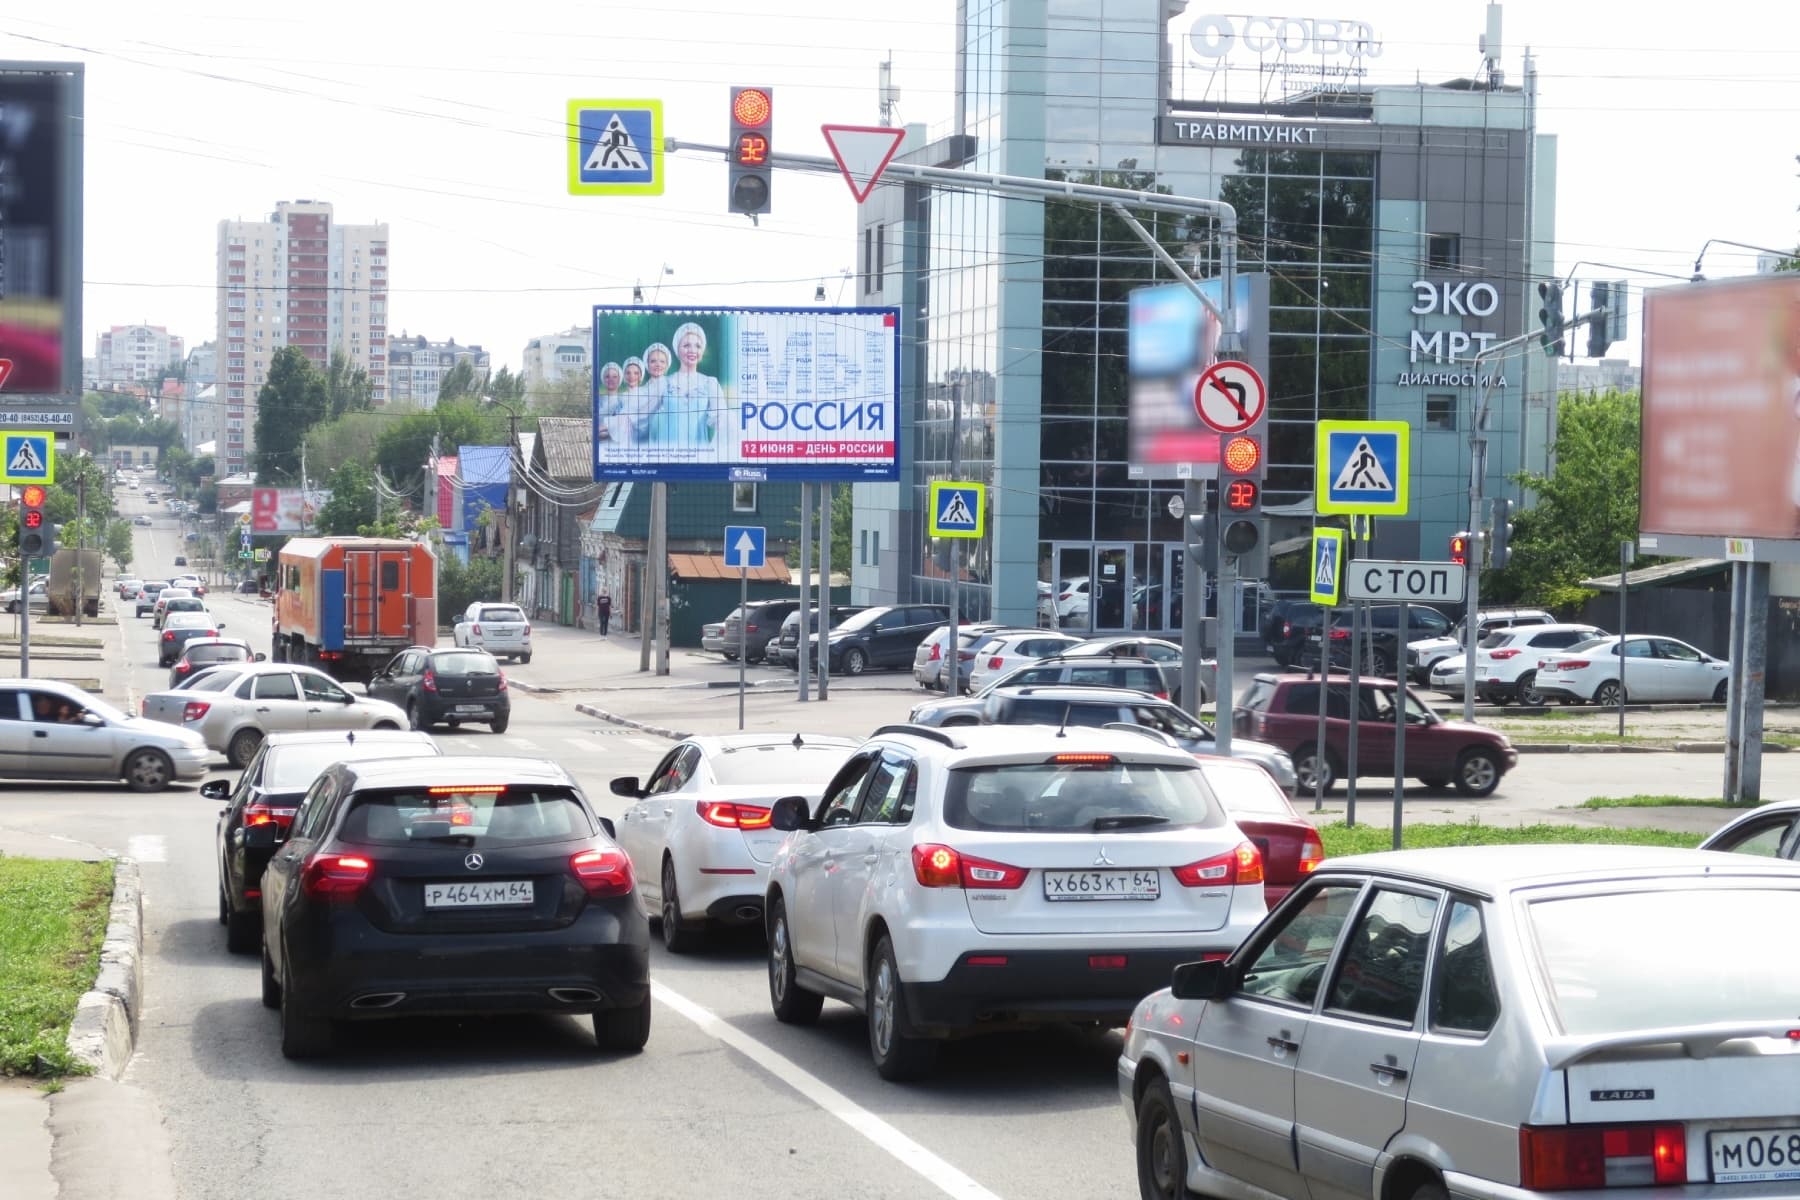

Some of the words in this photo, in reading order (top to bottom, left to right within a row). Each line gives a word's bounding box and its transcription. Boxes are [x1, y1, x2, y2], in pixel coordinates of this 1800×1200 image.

[1174, 122, 1318, 144] ТРАВМПУНКТ
[741, 138, 766, 160] 32
[1411, 281, 1499, 316] ЭКО
[1410, 330, 1497, 365] МРТ
[40, 414, 72, 423] 45-40-40
[741, 401, 884, 431] РОССИЯ
[744, 443, 757, 453] 12
[760, 443, 794, 453] ИЮНЯ
[805, 443, 836, 454] ДЕНЬ
[839, 443, 884, 453] РОССИИ
[1231, 484, 1252, 506] 32
[26, 512, 41, 527] 32
[1364, 568, 1448, 595] СТОП
[1599, 1091, 1648, 1099] LADA
